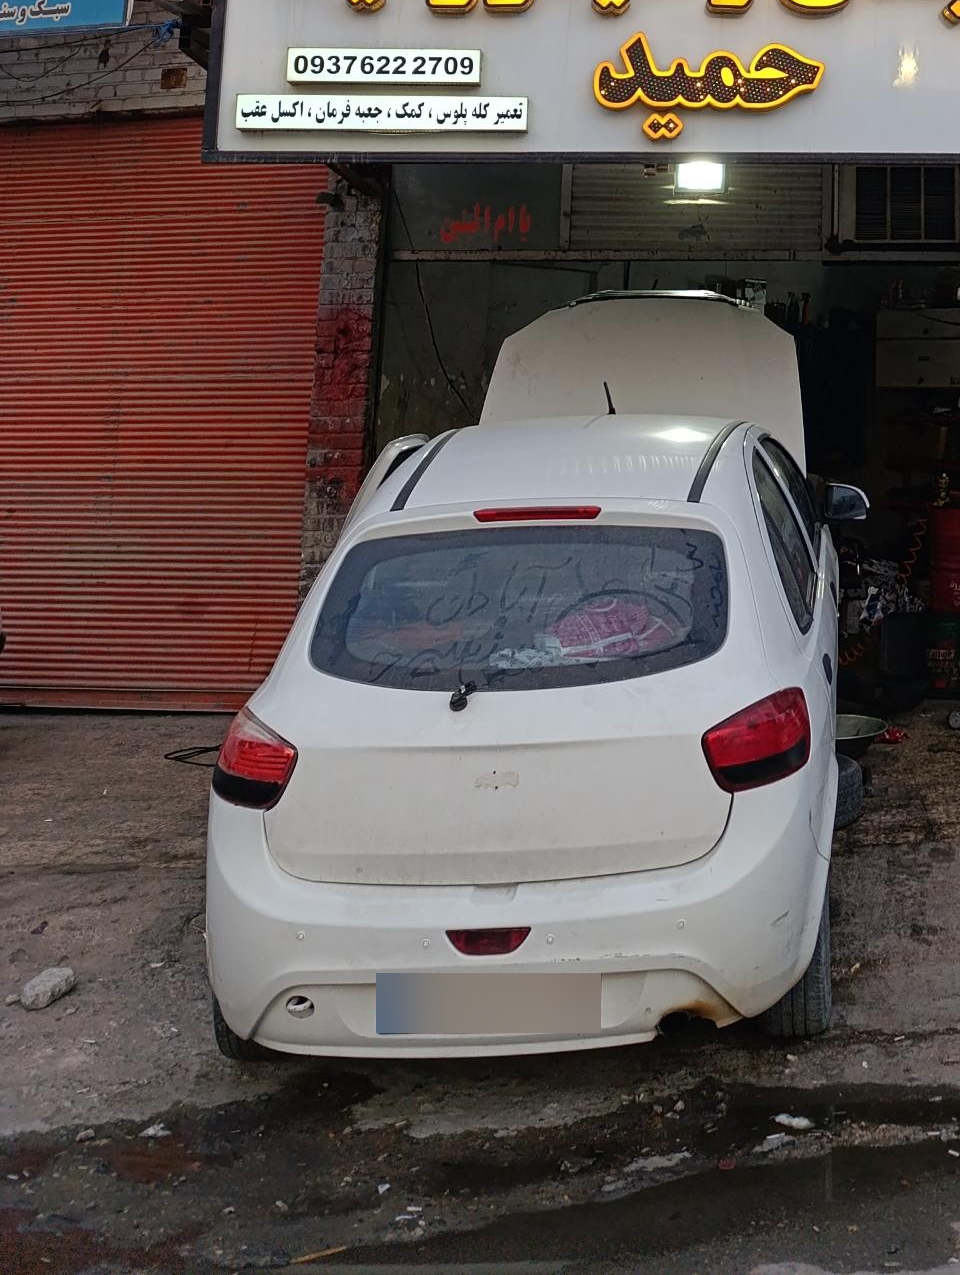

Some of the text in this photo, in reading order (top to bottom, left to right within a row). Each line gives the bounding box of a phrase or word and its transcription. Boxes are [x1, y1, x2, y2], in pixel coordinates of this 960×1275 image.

[293, 54, 475, 77] 09376222709
[593, 32, 825, 141] حمید
[241, 100, 267, 122] عقب
[271, 100, 304, 123] اکسل
[315, 99, 351, 124] فرمان
[355, 105, 383, 123] جعبه
[395, 101, 425, 119] کمک
[436, 101, 467, 125] پلوس
[472, 102, 490, 119] کله
[493, 102, 523, 125] تعمیر
